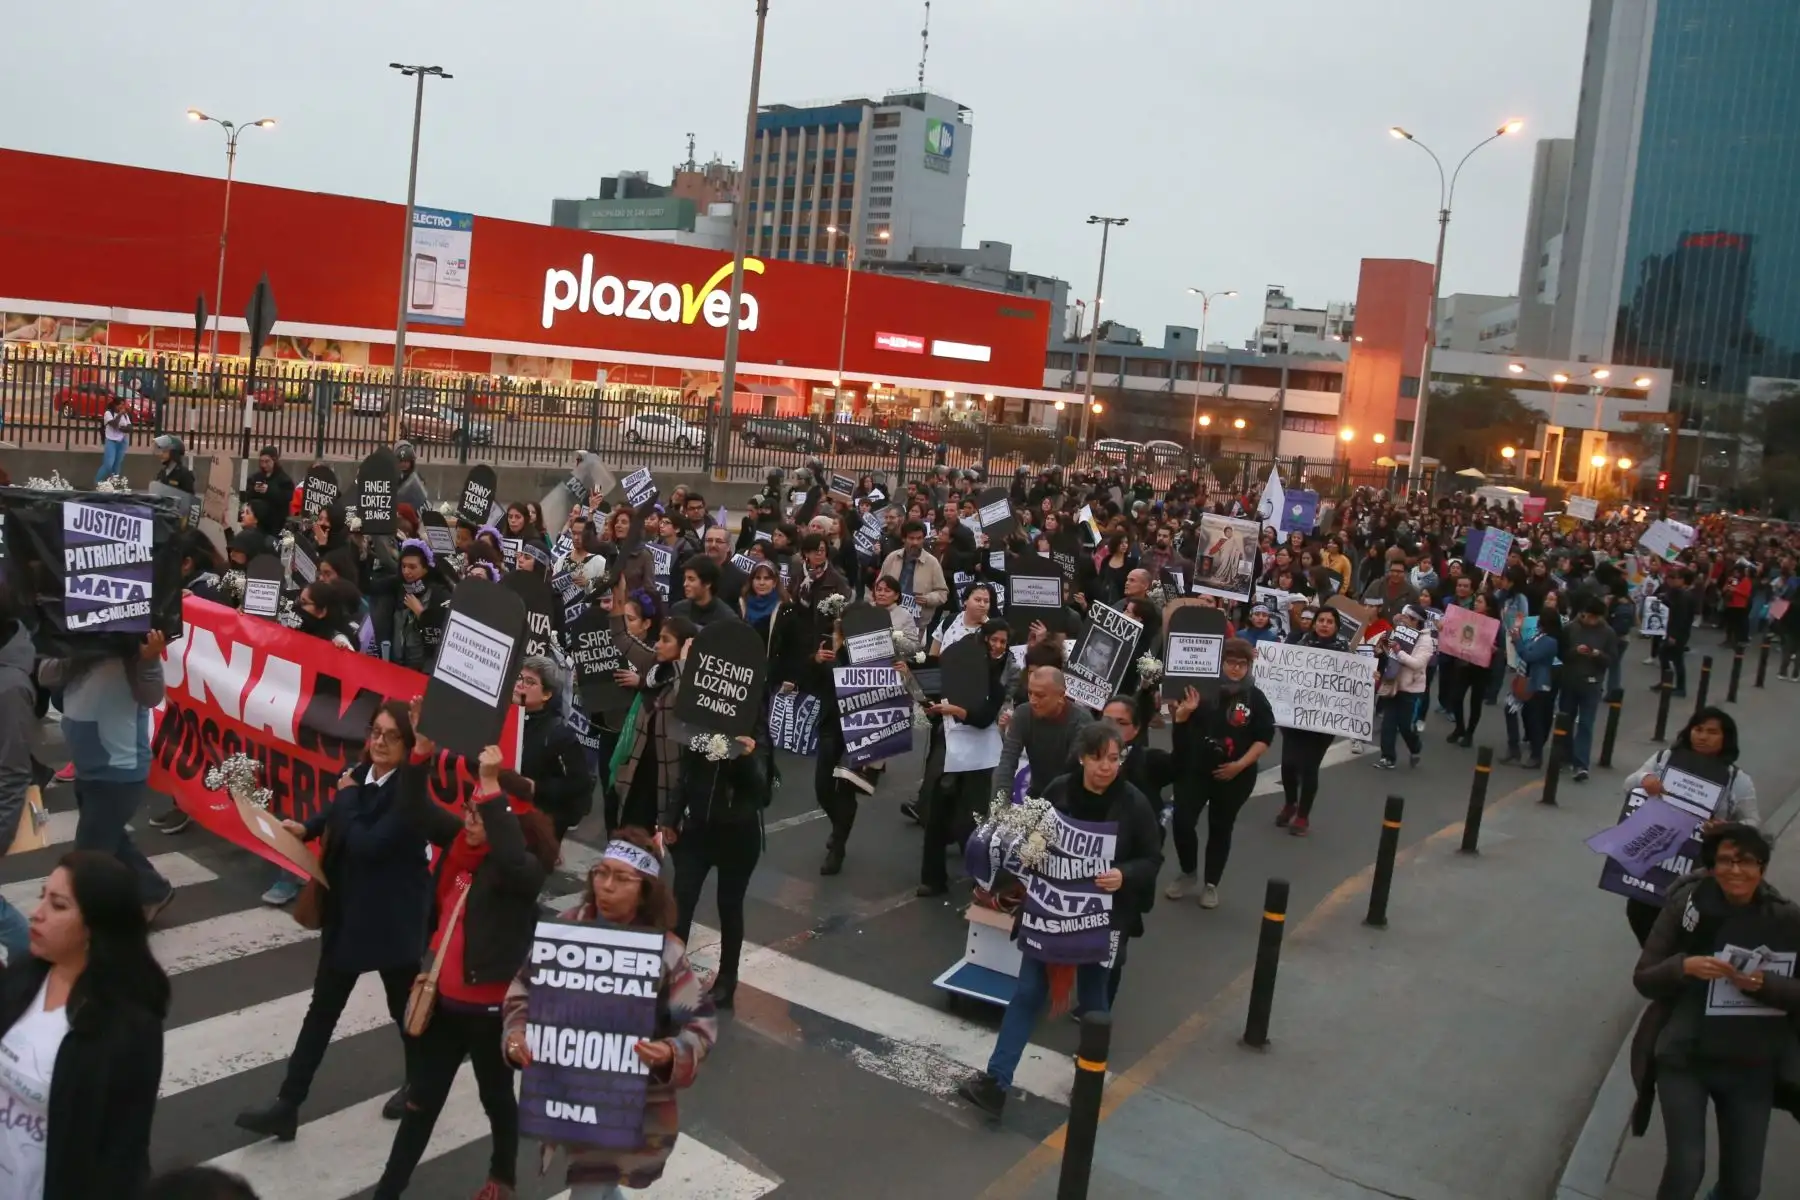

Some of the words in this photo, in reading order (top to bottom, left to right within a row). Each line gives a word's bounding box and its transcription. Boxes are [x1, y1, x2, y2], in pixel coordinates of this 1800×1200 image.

[412, 212, 453, 228] ELECTRO
[307, 476, 337, 496] SANTUSA
[364, 481, 391, 493] ANGIE
[465, 491, 489, 510] TICONA
[468, 481, 492, 498] DANNY
[361, 495, 392, 508] CORTEZ
[73, 507, 142, 542] JUSTICIA
[64, 543, 153, 571] PATRIARCAL
[70, 577, 145, 601] MATA
[1088, 603, 1106, 624] SE
[1103, 611, 1140, 647] BUSCA
[699, 652, 754, 685] YESENIA
[841, 669, 897, 686] JUSTICIA
[1067, 660, 1093, 681] WALTER
[1094, 675, 1113, 693] RIOS
[1256, 646, 1277, 663] NO
[1279, 649, 1304, 669] NOS
[1306, 653, 1370, 680] REGALARON
[694, 672, 748, 701] LOZANO
[1254, 664, 1312, 688] NUESTROS
[1314, 674, 1372, 699] DERECHOS
[1293, 689, 1368, 719] ARRANCARLOS
[784, 690, 797, 749] PATRIARCA
[843, 710, 905, 728] MATA
[1293, 706, 1371, 736] PATRIARCADO
[1055, 822, 1104, 858] STICIA
[1029, 873, 1105, 914] MATA
[1622, 874, 1655, 893] UNA
[531, 940, 662, 978] PODER
[530, 969, 658, 998] JUDICIAL
[525, 1023, 651, 1075] NACIONAL
[545, 1100, 598, 1124] UNA
